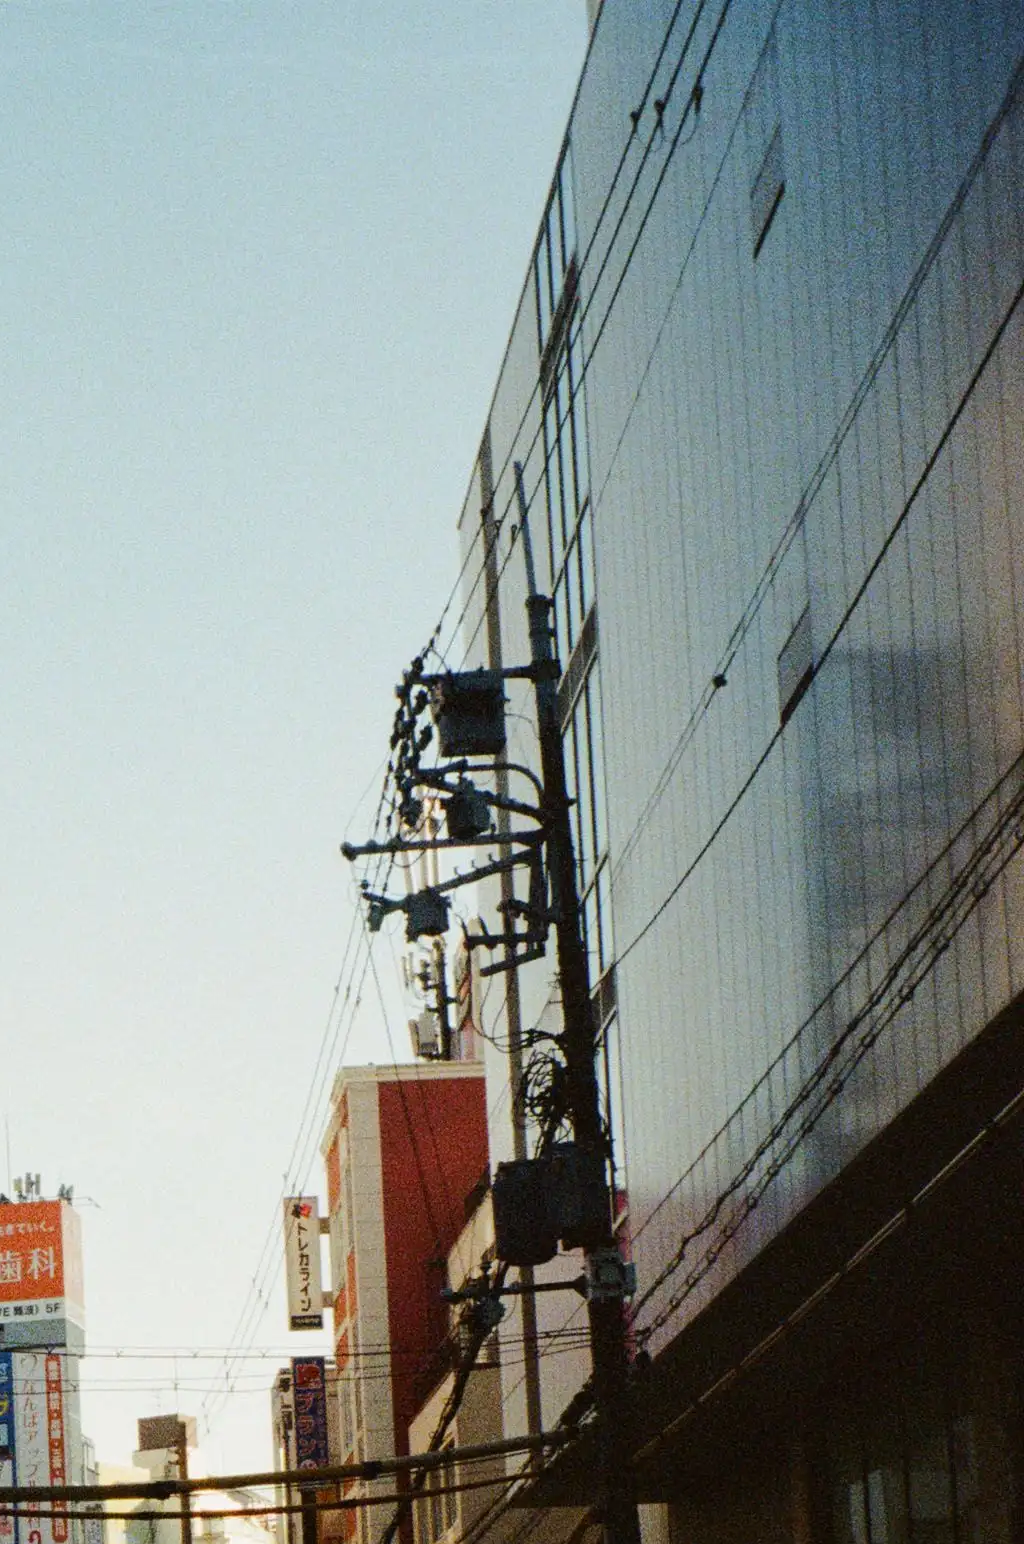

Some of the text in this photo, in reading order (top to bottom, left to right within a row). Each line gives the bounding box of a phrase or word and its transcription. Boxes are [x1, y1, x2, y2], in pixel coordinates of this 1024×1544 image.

[298, 1222, 312, 1312] トレカライン
